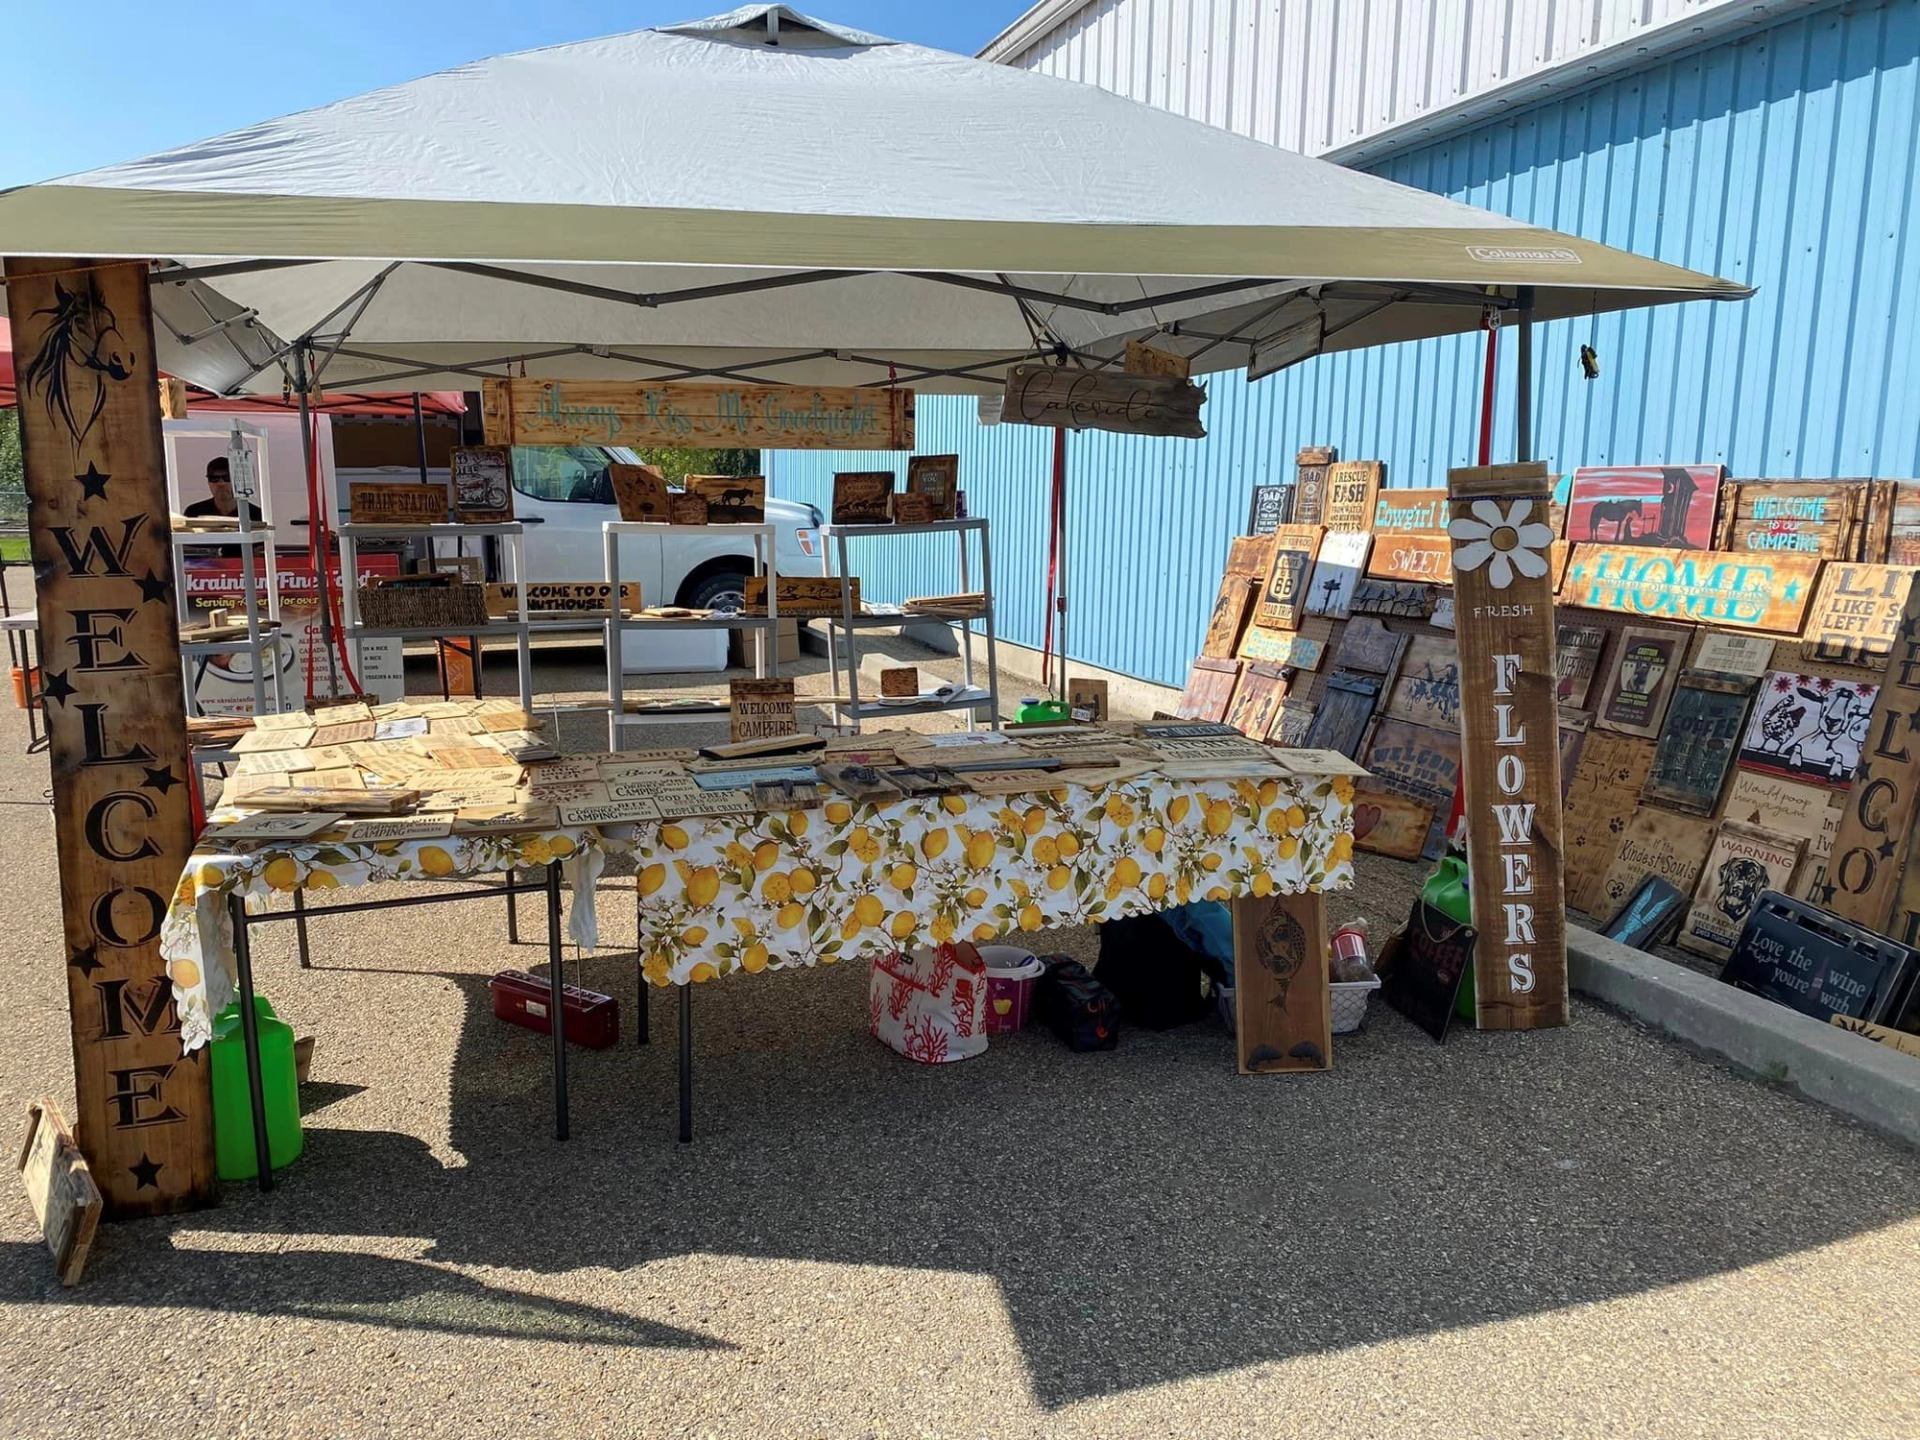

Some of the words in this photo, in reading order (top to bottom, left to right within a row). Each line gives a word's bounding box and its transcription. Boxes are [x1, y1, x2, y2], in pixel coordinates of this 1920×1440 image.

[1474, 247, 1557, 260] Coleman
[634, 387, 692, 436] Kiss
[701, 392, 752, 433] Me
[1304, 471, 1321, 483] DAD
[1339, 471, 1368, 483] RESCUE
[399, 491, 441, 513] STATION
[1263, 491, 1281, 502] DAD
[1376, 499, 1437, 531] Cowgirl
[1753, 496, 1828, 525] WELCOME
[1328, 522, 1361, 531] BOTTLES
[1747, 531, 1821, 553] CAMPFIRE
[1389, 548, 1446, 575] SWEET
[500, 585, 570, 598] WCOME
[575, 586, 596, 598] TO
[599, 585, 629, 598] OR
[1274, 577, 1293, 595] 66
[1587, 551, 1774, 623] HOME
[195, 597, 235, 608] Serving
[1473, 604, 1534, 618] FRESH
[1831, 598, 1876, 616] LIKE
[1823, 614, 1869, 632] LEFT
[738, 702, 793, 715] WELCOME
[738, 720, 793, 737] CAMPFIRE
[616, 786, 664, 797] CAMPING
[699, 790, 736, 799] GREAT
[567, 810, 618, 822] CAMPING
[665, 807, 698, 817] PEOPLE
[699, 806, 716, 814] ARE
[1490, 653, 1538, 993] FLOWERS
[352, 826, 405, 839] CAMPING
[1618, 839, 1662, 869] Kindest
[1661, 854, 1697, 880] Souls
[1721, 839, 1794, 869] WARNING
[1750, 927, 1785, 957] Love
[1787, 944, 1813, 972] the
[1829, 968, 1867, 999] wine
[1820, 990, 1850, 1015] with
